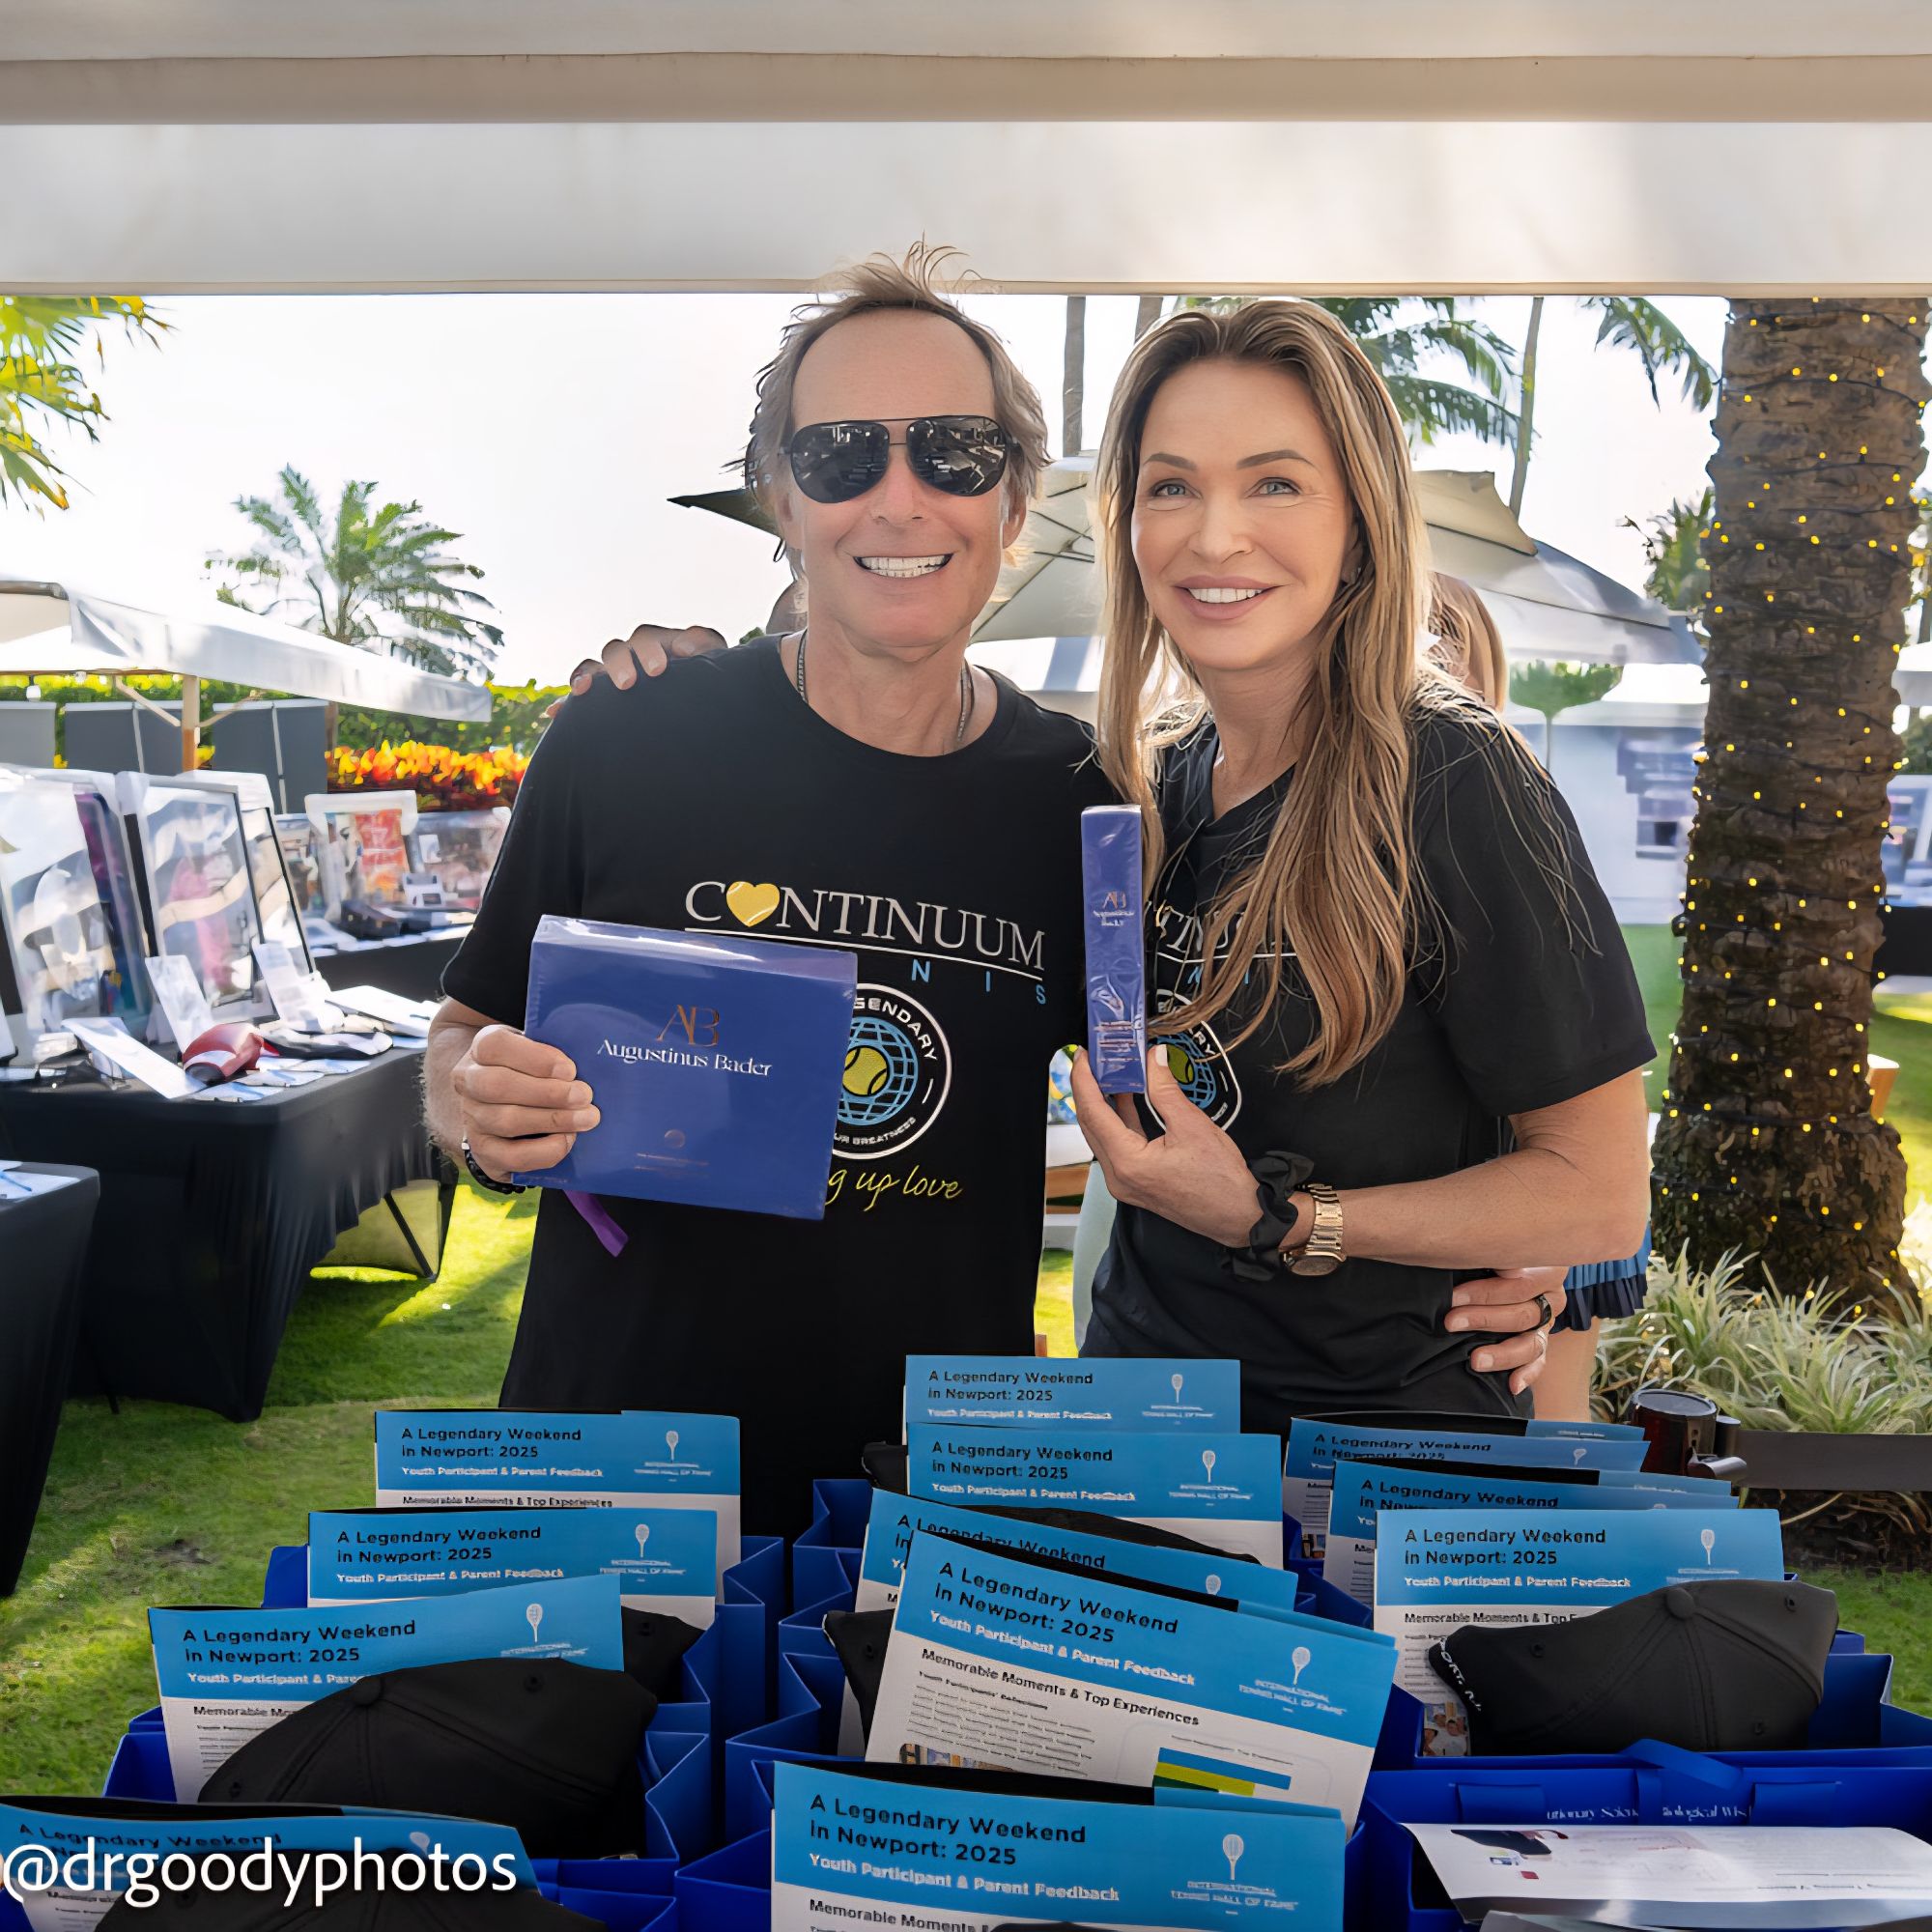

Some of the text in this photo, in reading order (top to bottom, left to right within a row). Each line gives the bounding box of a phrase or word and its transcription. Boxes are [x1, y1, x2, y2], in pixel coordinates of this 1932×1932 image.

[854, 998, 937, 1060] GENDARY
[597, 1039, 772, 1077] Augustinus Bader
[856, 1172, 899, 1211] up
[903, 1165, 963, 1200] love
[929, 1371, 1094, 1385] A Legendary Weekend
[947, 1388, 1011, 1401] Newport:
[1017, 1389, 1053, 1401] 2025
[402, 1429, 582, 1442] A Legendary Weekend
[1315, 1434, 1325, 1442] A
[1331, 1435, 1413, 1449] Legendary
[420, 1446, 494, 1459] Newport:
[499, 1446, 538, 1458] 2025
[932, 1441, 1113, 1462] A Legendary Weekend
[951, 1462, 1022, 1478] Newport:
[1028, 1465, 1068, 1479] 2025
[1361, 1479, 1558, 1508] A Legendary Weekend
[897, 1515, 910, 1528] A
[337, 1526, 540, 1546] A Legendary Weekend
[1406, 1528, 1605, 1546] A Legendary Weekend
[359, 1549, 440, 1564] Newport:
[448, 1548, 492, 1561] 2025
[1427, 1550, 1507, 1566] Newport:
[1513, 1550, 1557, 1565] 2025
[939, 1562, 1179, 1634] A Legendary Weekend
[958, 1595, 1054, 1630] Newport:
[1061, 1619, 1115, 1642] 2025
[183, 1620, 415, 1644] A Legendary Weekend
[210, 1649, 301, 1665] Newport:
[309, 1648, 359, 1662] 2025
[930, 1610, 1195, 1686] Youth Participant & Parent Feedback
[922, 1648, 998, 1681] Memorable
[1002, 1671, 1065, 1696] Moments
[1069, 1688, 1079, 1700] &
[1084, 1690, 1110, 1708] Top
[1113, 1698, 1200, 1725] Experiences
[19, 1824, 33, 1834] A
[810, 1794, 1086, 1843] A Legendary Weekend
[838, 1827, 947, 1858] Newport:
[955, 1844, 1015, 1865] 2025
[810, 1854, 857, 1874] Youth
[862, 1862, 952, 1888] Participant
[974, 1877, 1029, 1896] Parent
[1035, 1884, 1120, 1902] Feedback
[810, 1899, 896, 1925] Memorable
